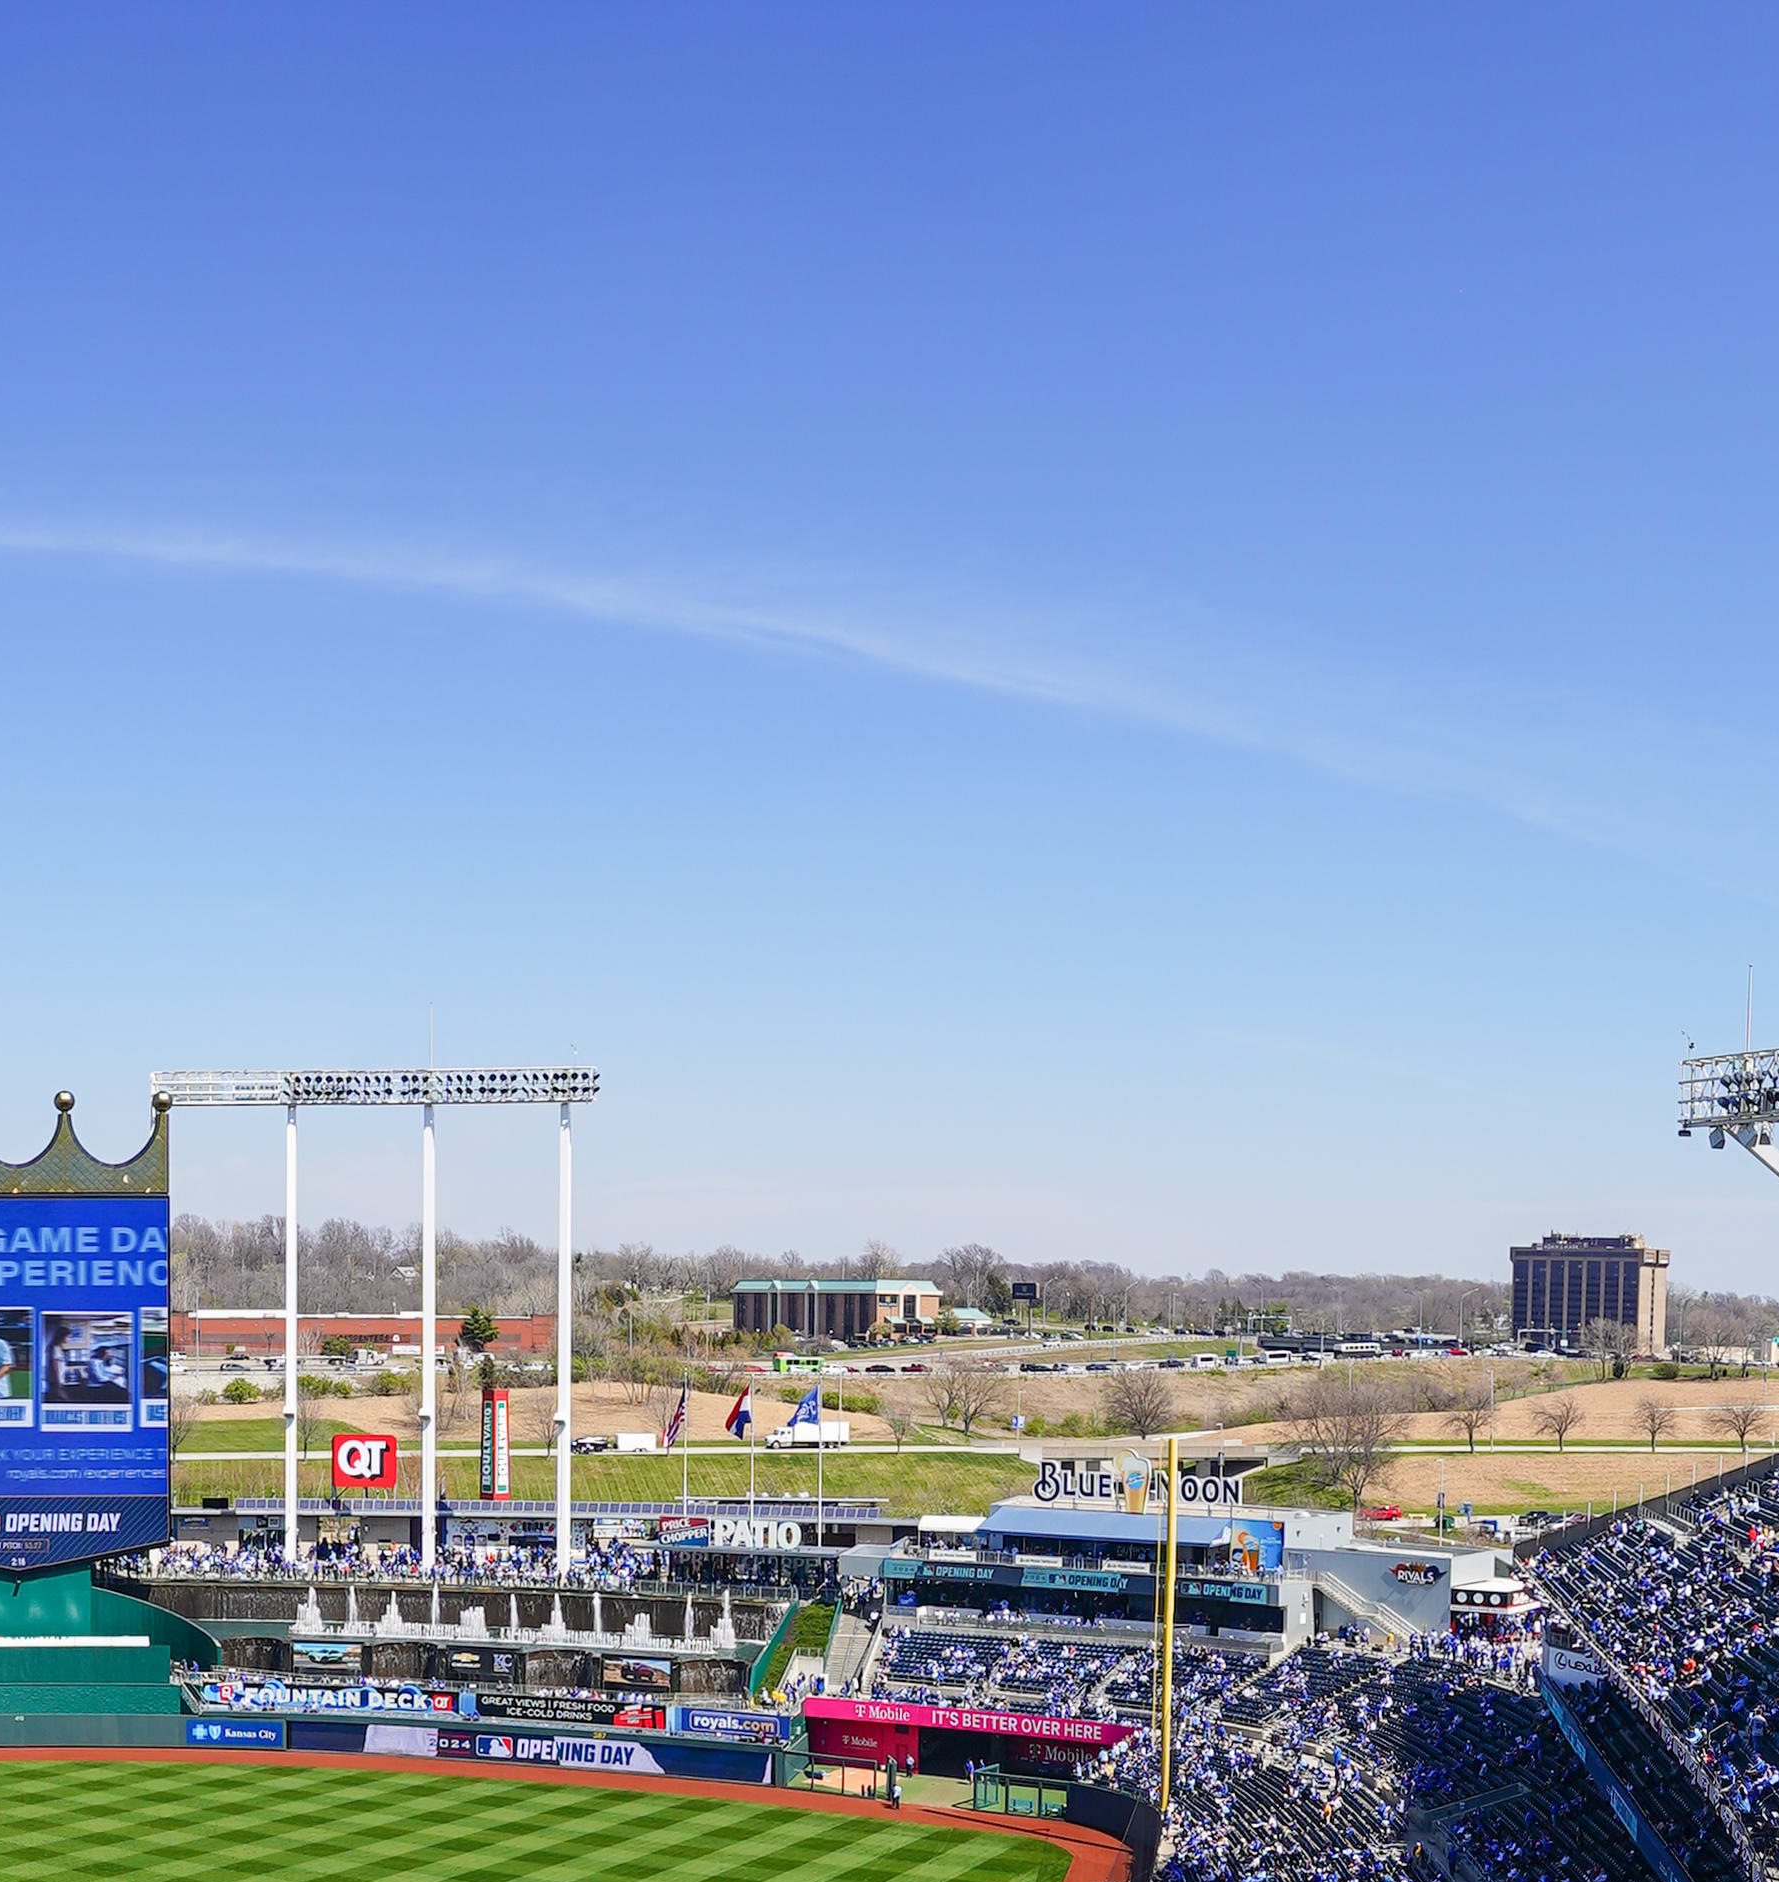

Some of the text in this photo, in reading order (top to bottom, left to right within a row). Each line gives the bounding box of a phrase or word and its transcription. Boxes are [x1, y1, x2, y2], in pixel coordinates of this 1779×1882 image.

[483, 1406, 492, 1486] BOULEVARD
[497, 1408, 506, 1486] BOULEVARD
[13, 1449, 53, 1461] YOUR
[59, 1449, 153, 1461] EXPERIENCE
[338, 1439, 388, 1478] QT
[1034, 1460, 1113, 1501] BLUE
[5, 1513, 83, 1532] OPENING
[86, 1512, 121, 1532] DAY
[662, 1517, 691, 1531] PRICE
[660, 1528, 708, 1544] CHOPPER
[715, 1519, 802, 1549] PATIO
[935, 1566, 994, 1580] OPENING DAY
[1397, 1570, 1435, 1582] RIVALS
[1067, 1574, 1129, 1590] OPENING DAY
[1202, 1583, 1264, 1600] OPENING DAY
[245, 1688, 363, 1708] FOUNTAIN
[369, 1692, 428, 1710] DECK
[481, 1696, 615, 1713] GREAT VIEWS FRESH FOOD
[506, 1707, 592, 1721] ICE-COLD DRINKS
[868, 1705, 910, 1722] Mobile
[693, 1714, 776, 1733] royals.com
[931, 1711, 1102, 1741] IT'S BETTER OVER HERE
[225, 1728, 277, 1741] Kansas City
[851, 1736, 879, 1748] Mobile
[428, 1737, 635, 1767] 2024 OPENING DAY
[1044, 1746, 1094, 1765] Mobile
